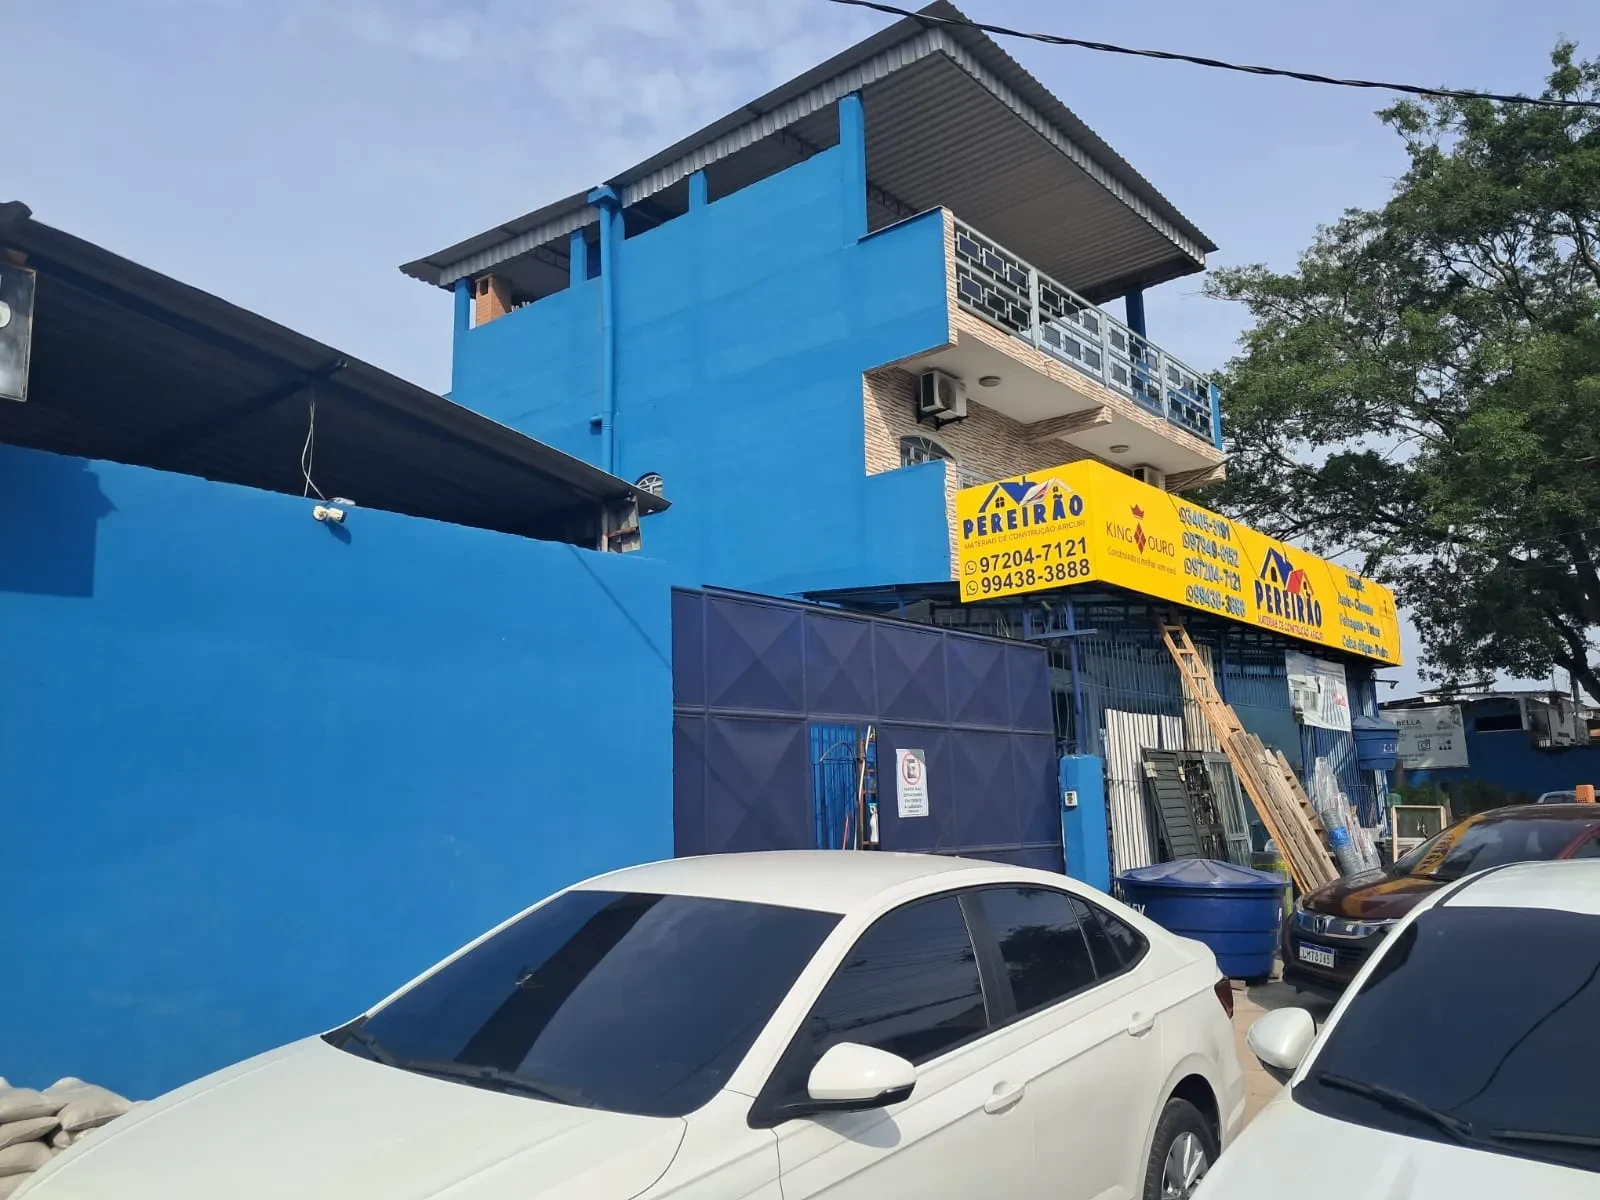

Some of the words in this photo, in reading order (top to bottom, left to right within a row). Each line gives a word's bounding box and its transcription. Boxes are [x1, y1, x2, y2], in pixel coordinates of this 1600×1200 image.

[963, 493, 1084, 539] PEREIRÃO
[998, 534, 1008, 543] DE
[1008, 525, 1055, 540] CONSTRUÇÃO
[980, 536, 1086, 573] 97204-7121
[1106, 521, 1133, 543] KING
[1147, 536, 1175, 557] OURO
[981, 558, 1091, 594] 99438-3888
[1254, 580, 1322, 628] PEREIRÃO
